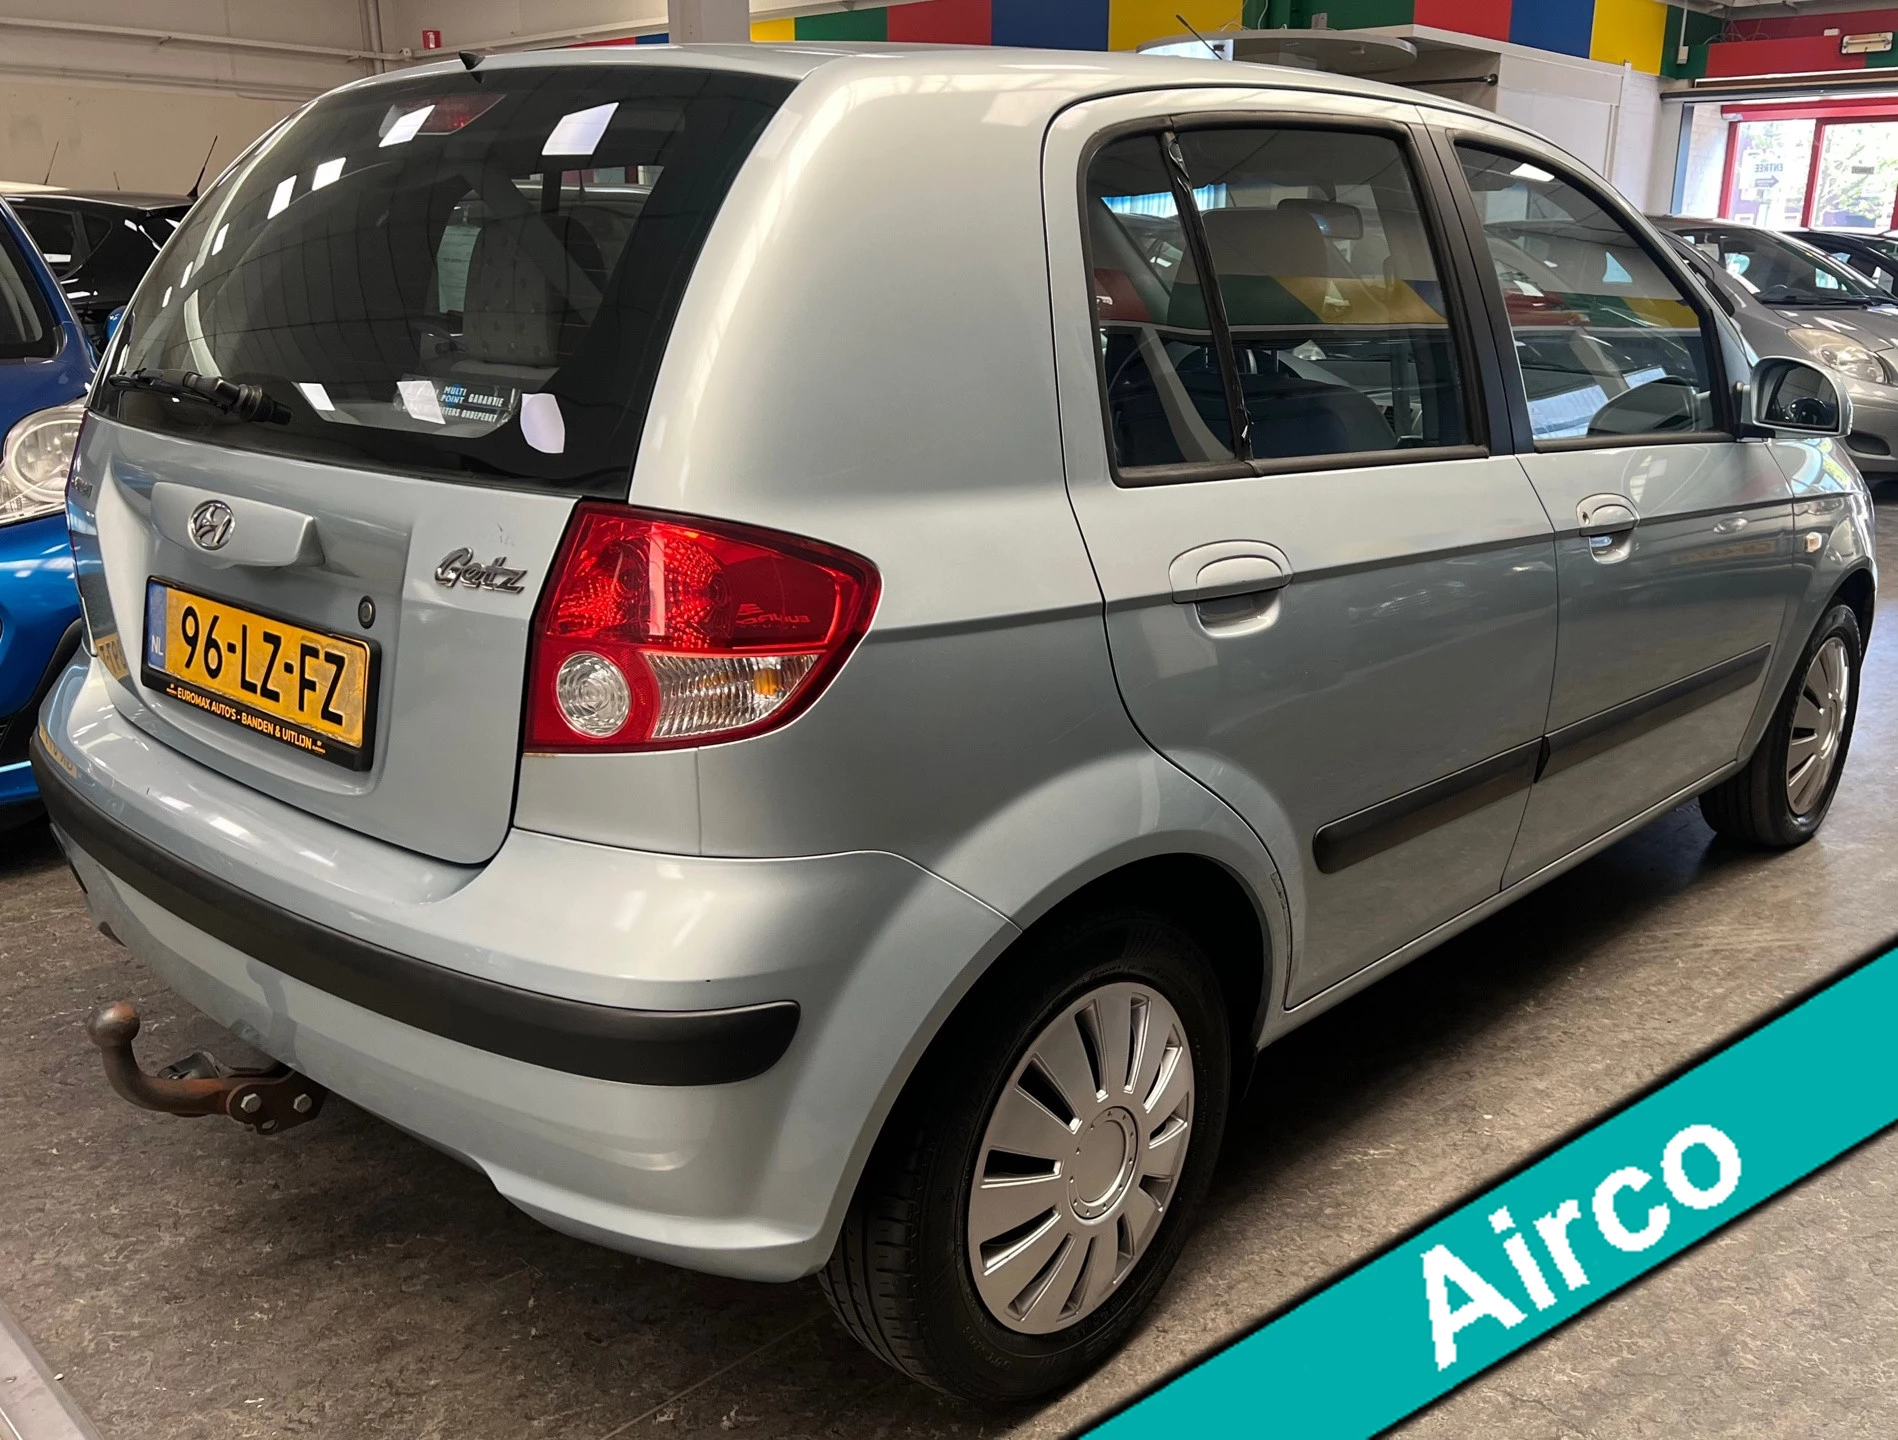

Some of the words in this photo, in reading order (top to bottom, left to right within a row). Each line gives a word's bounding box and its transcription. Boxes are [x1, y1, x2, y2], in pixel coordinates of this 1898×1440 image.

[440, 394, 465, 404] POINT
[443, 386, 467, 396] MULTI
[467, 393, 504, 407] GARANTIE
[434, 547, 528, 595] Getz
[151, 635, 164, 656] NL
[181, 605, 346, 727] 96-LZ-FZ
[177, 686, 211, 710] EUROMAX
[211, 701, 237, 720] AUTO'S
[241, 712, 274, 735] BANDEN
[274, 725, 281, 737] &
